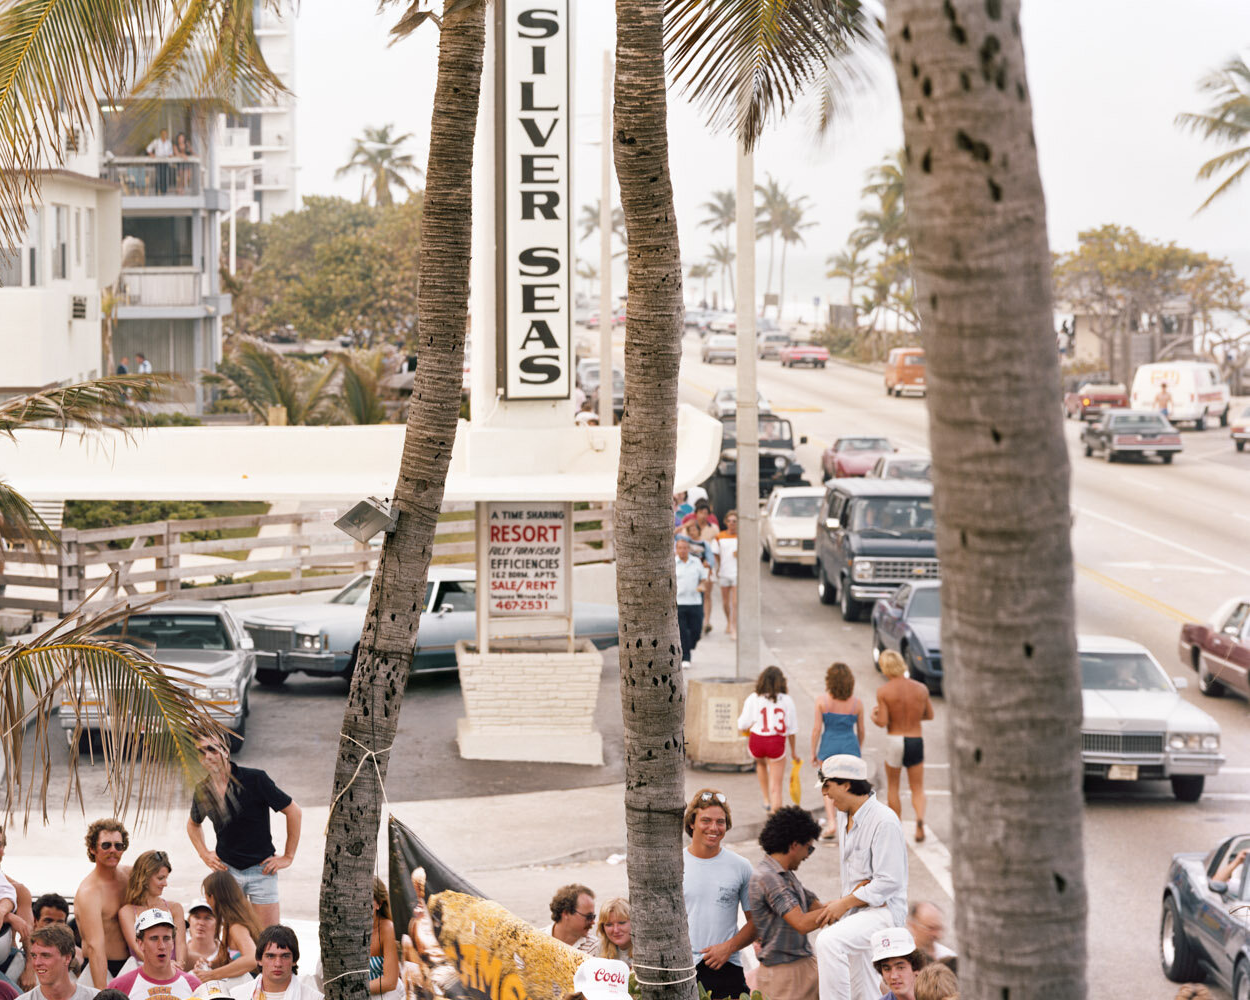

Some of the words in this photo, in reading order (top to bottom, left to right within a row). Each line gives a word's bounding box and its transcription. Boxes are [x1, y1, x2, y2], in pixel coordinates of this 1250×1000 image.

[516, 8, 561, 221] SILVER
[518, 246, 562, 385] SEAS
[491, 511, 499, 519] A
[501, 510, 524, 520] TIME
[526, 510, 565, 520] SHARING
[490, 525, 562, 543] RESORT
[488, 546, 511, 556] FULLY
[513, 546, 561, 556] FURNISHED
[490, 558, 560, 570] EFFICIENCIES
[495, 600, 549, 611] 467-2531
[759, 706, 787, 734] 13
[593, 968, 626, 985] Coors
